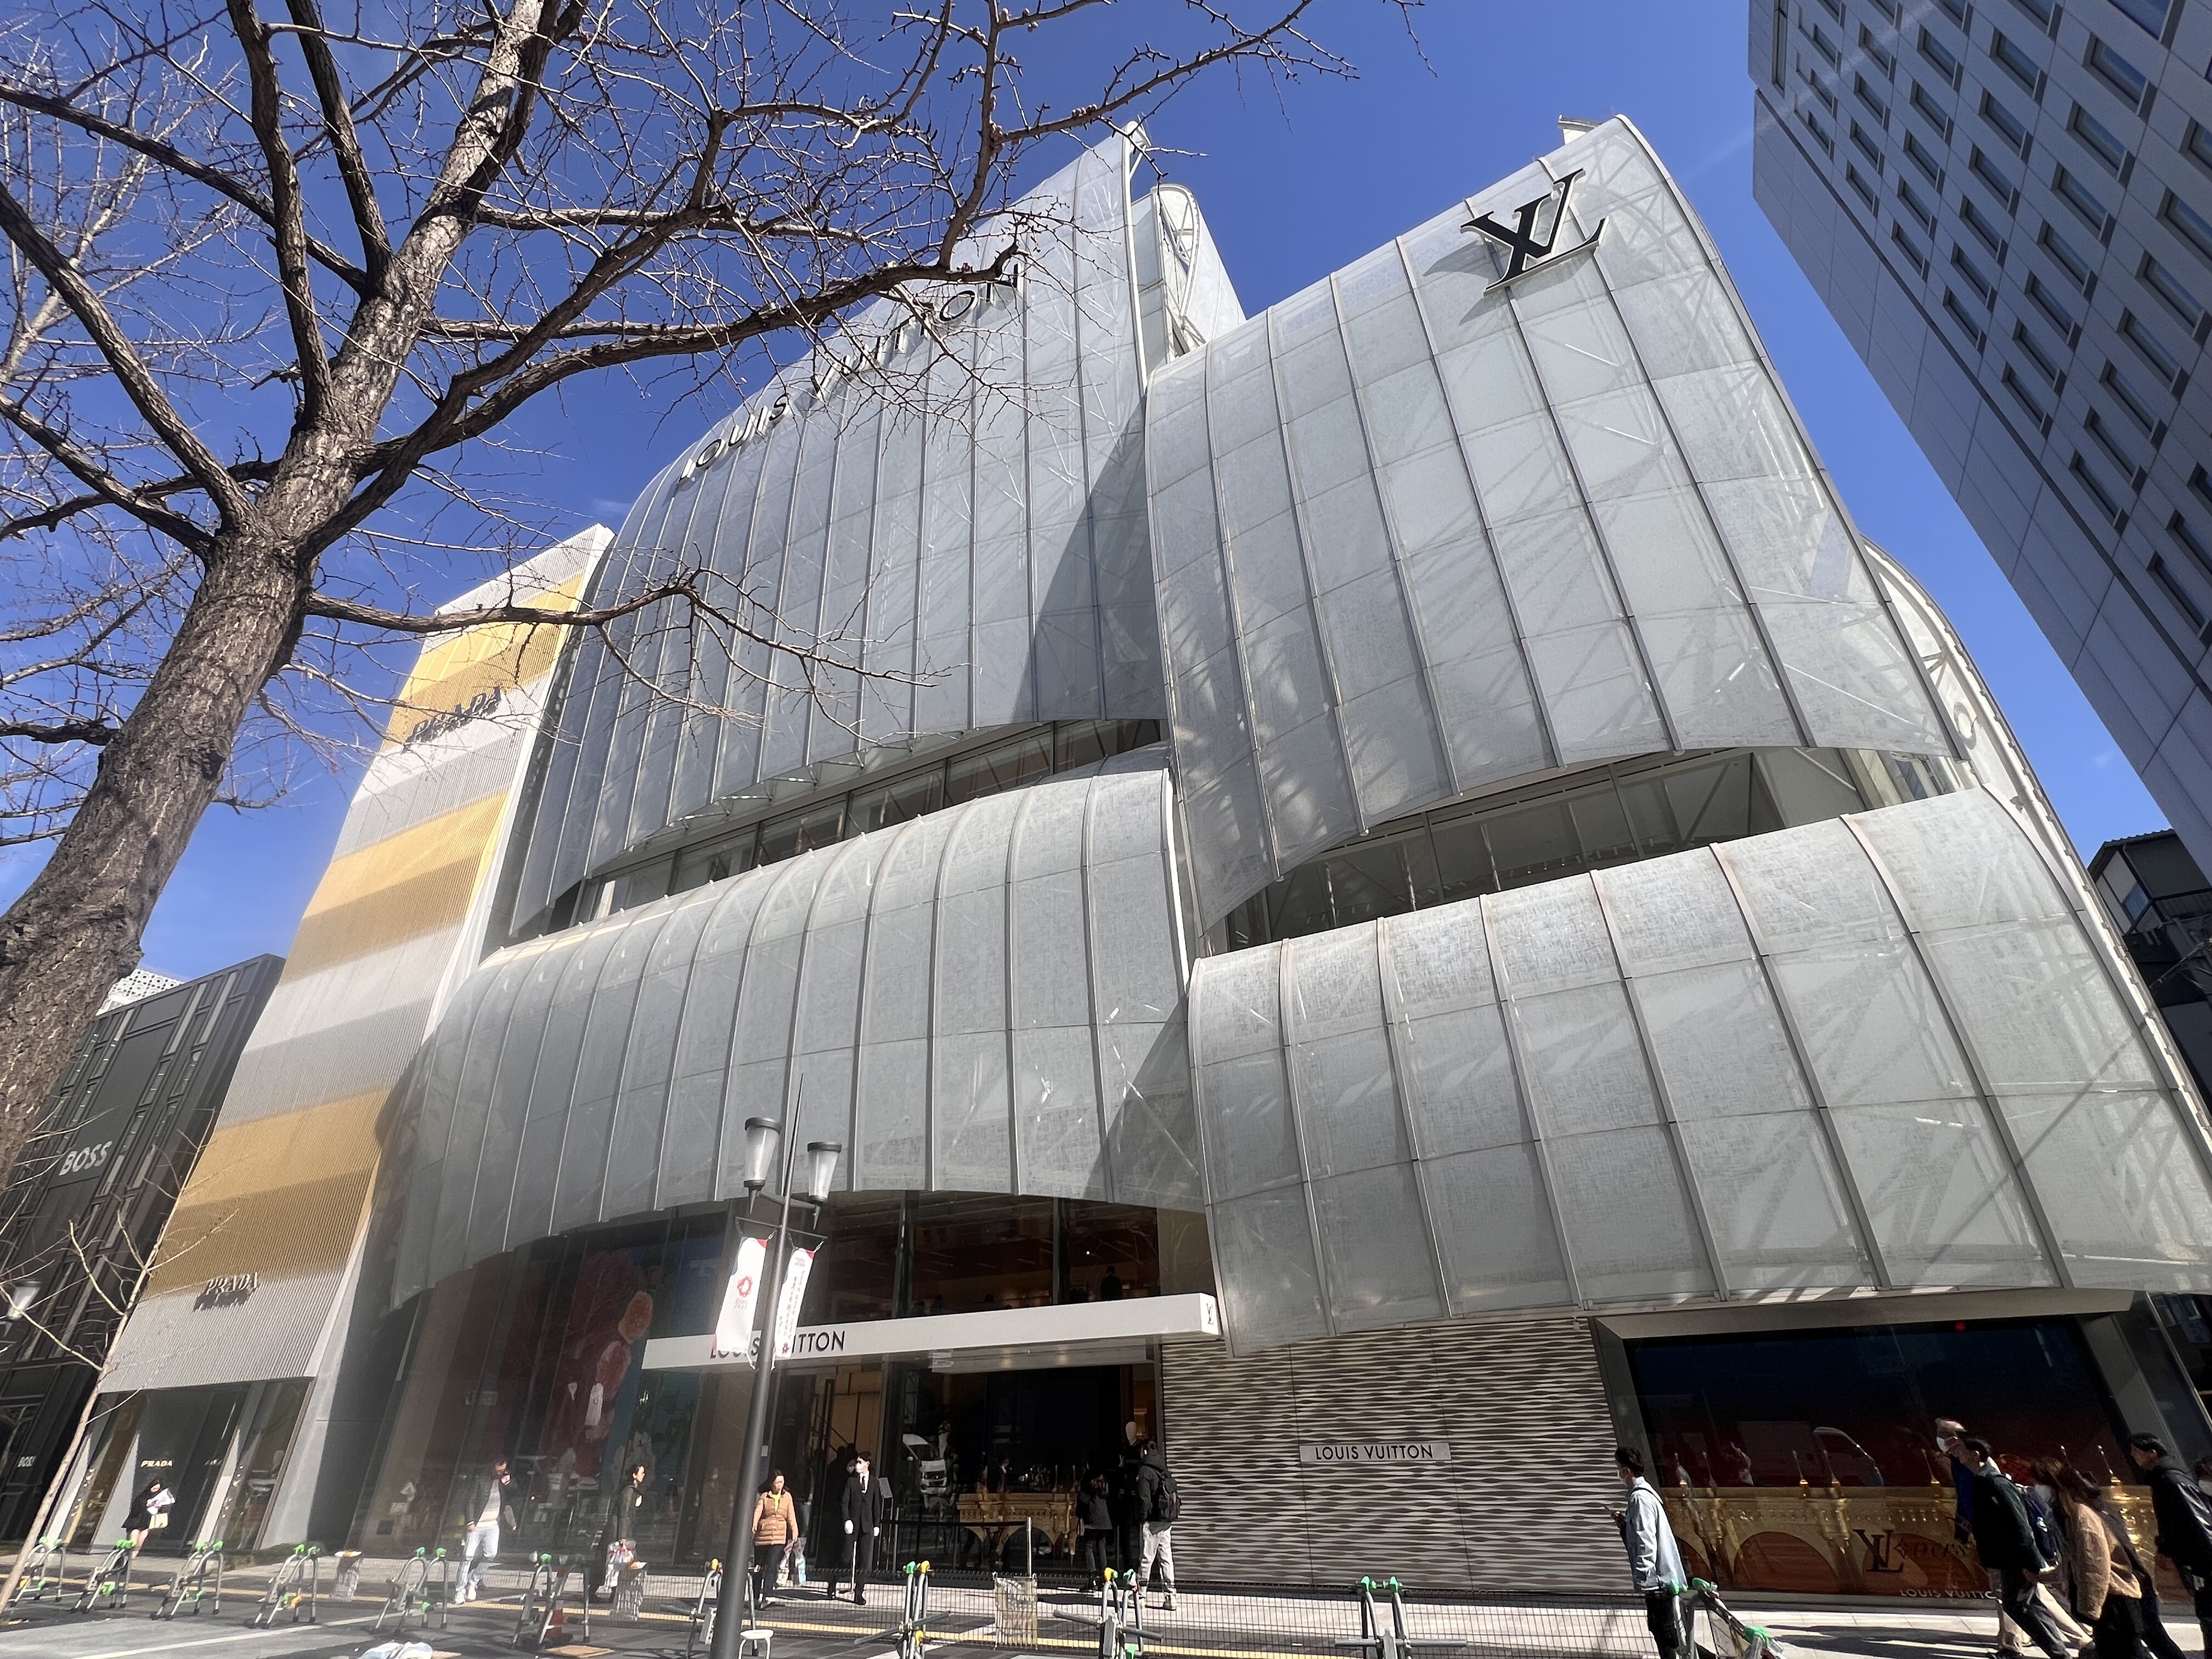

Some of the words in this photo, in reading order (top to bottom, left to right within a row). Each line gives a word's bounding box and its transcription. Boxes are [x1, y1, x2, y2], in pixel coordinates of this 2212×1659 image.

[59, 1140, 113, 1176] BOSS
[791, 1330, 845, 1354] ITTON
[1316, 1446, 1359, 1460] LOUIS
[1364, 1444, 1433, 1459] VUITTON
[1899, 1589, 1942, 1598] LOUIS
